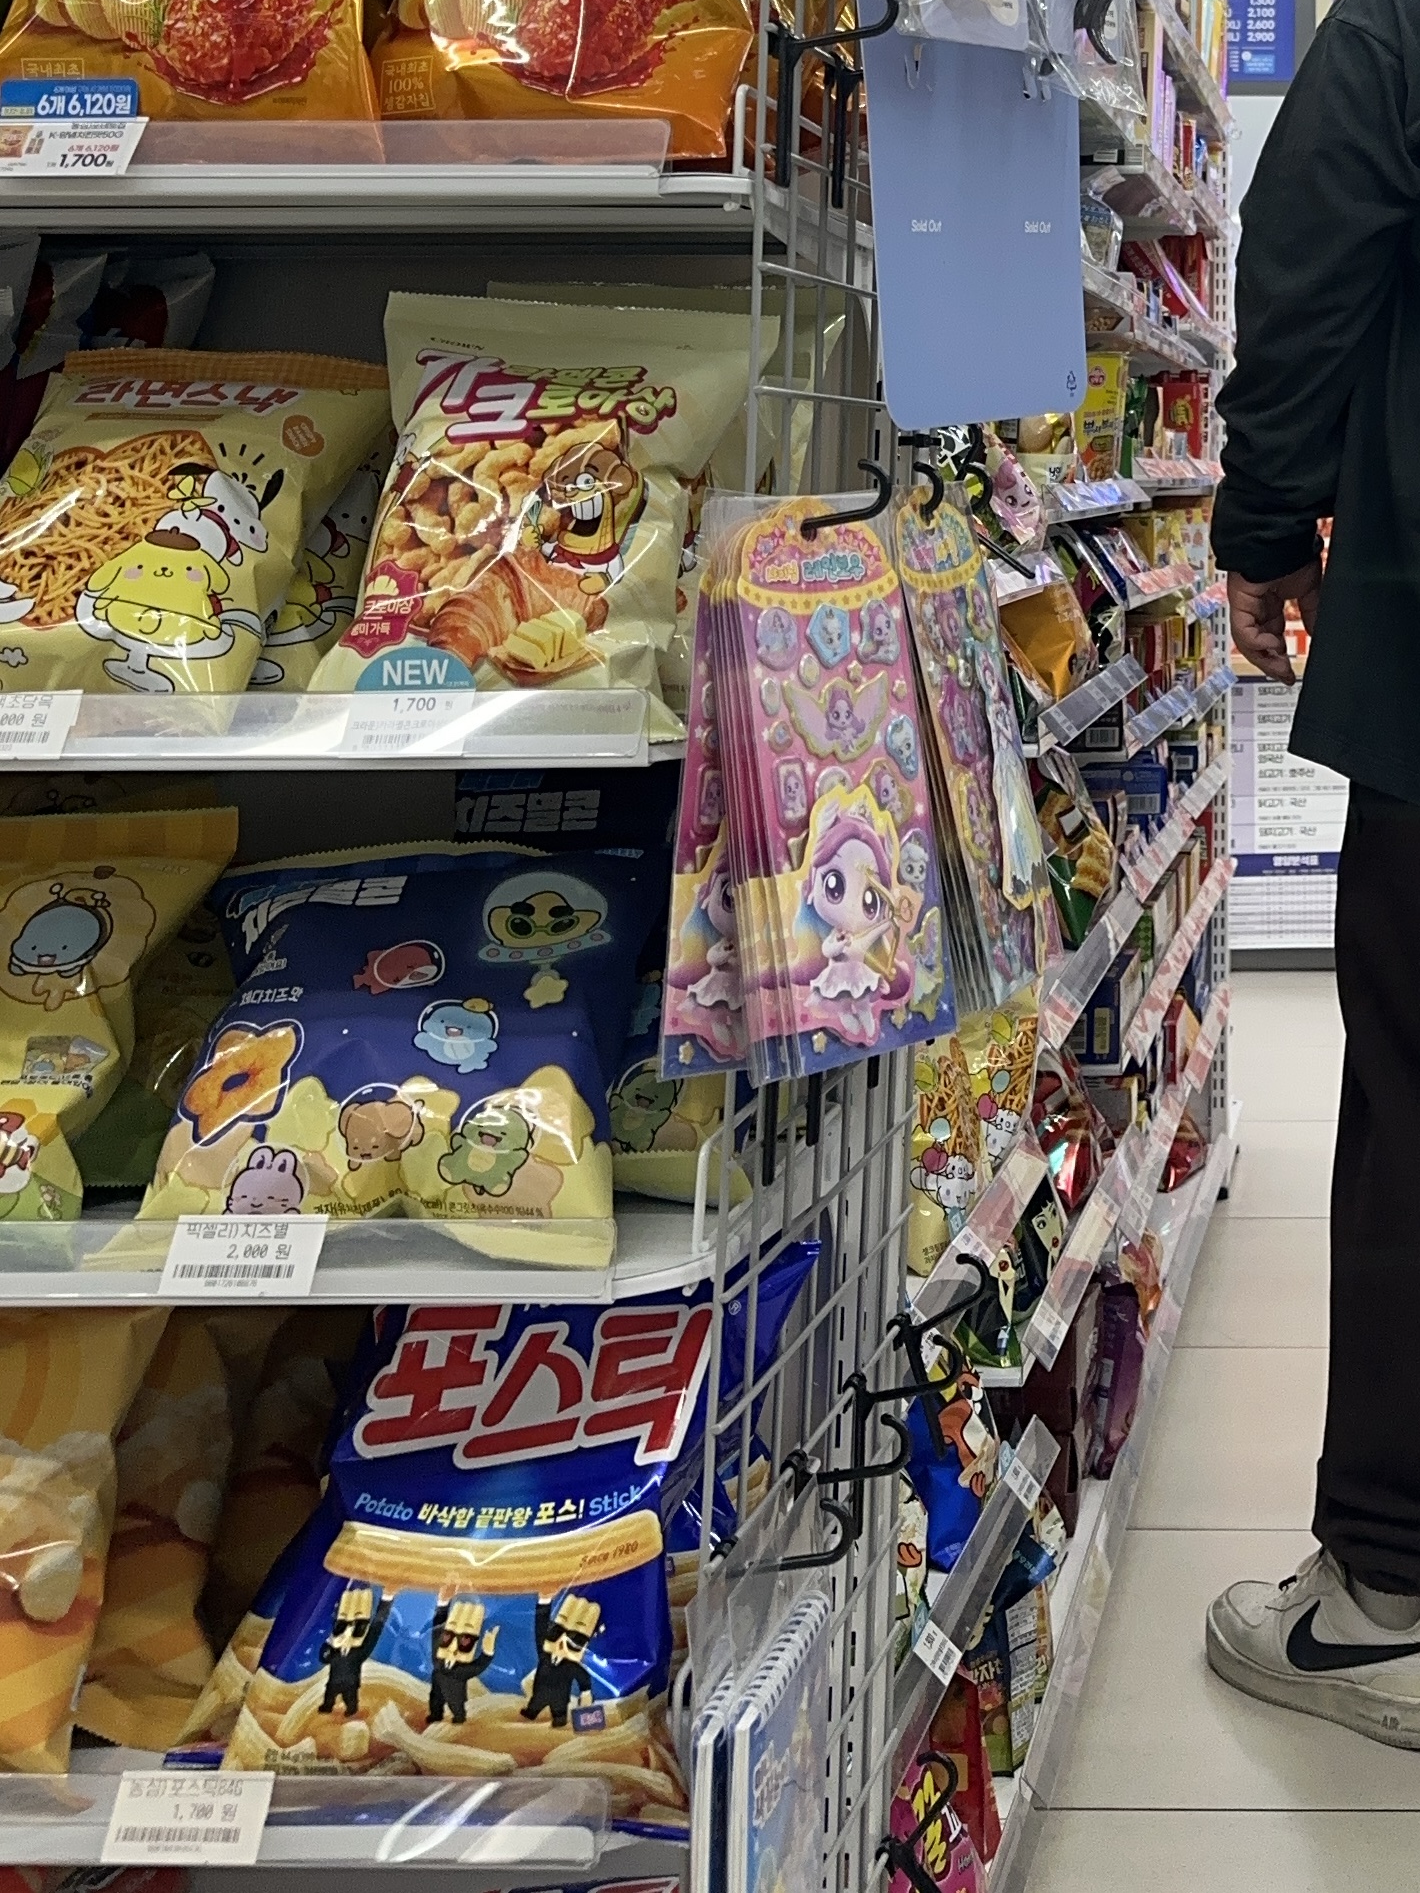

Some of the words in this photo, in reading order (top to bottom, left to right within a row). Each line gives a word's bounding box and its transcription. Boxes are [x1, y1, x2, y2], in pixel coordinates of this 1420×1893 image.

[26, 61, 81, 78] 국내최초
[384, 59, 430, 78] 국내최초
[387, 78, 425, 94] 100%
[37, 94, 66, 116] 6개
[68, 93, 132, 117] 6,120원
[911, 219, 928, 232] Sold
[929, 219, 943, 232] Out
[74, 376, 300, 414] 라면스낵
[371, 621, 392, 636] 가득
[382, 659, 449, 687] NEW
[392, 697, 437, 713] 1,700
[31, 713, 49, 727] 원
[226, 1243, 269, 1260] 2,000
[275, 1243, 292, 1260] 원
[356, 1305, 721, 1468] 포스틱
[355, 1492, 414, 1523] Potato
[533, 1497, 586, 1527] 포스!
[588, 1484, 643, 1517] Stick
